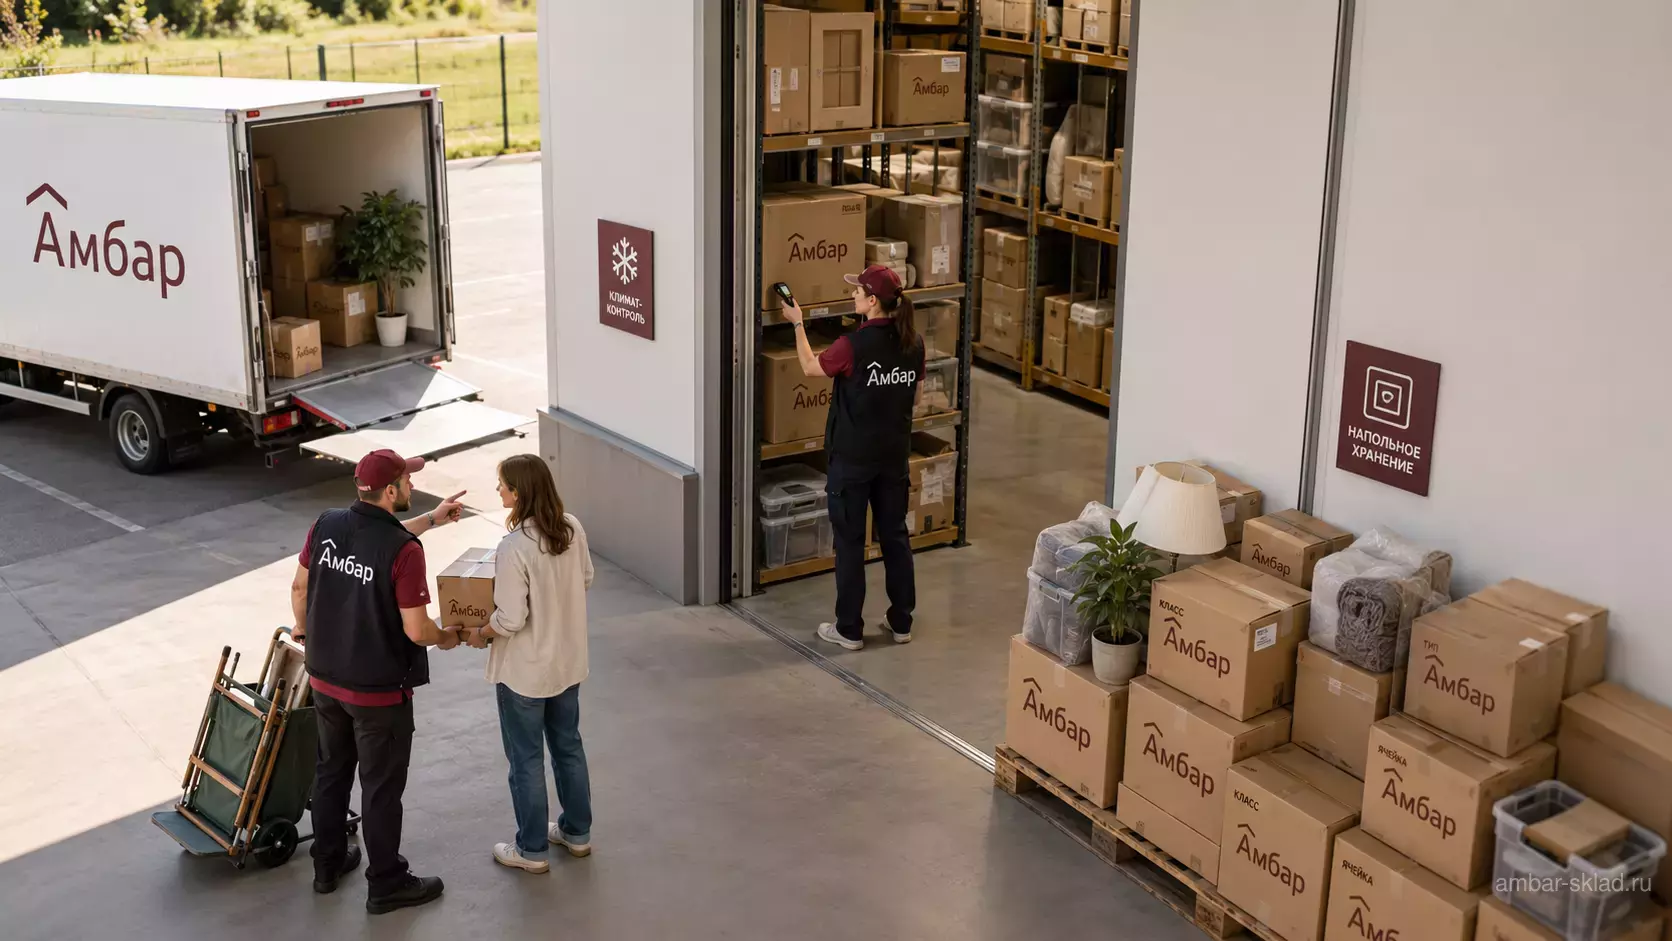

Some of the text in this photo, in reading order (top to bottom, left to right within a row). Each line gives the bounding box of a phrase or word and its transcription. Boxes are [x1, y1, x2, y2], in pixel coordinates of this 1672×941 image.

[912, 81, 950, 97] Амбар
[33, 211, 186, 299] Амбар
[787, 239, 848, 263] Амбар
[606, 304, 645, 324] КОНТРОЛЬ
[609, 291, 643, 308] КЛИМАТ-
[866, 365, 917, 387] Амбар
[793, 388, 833, 410] Амба
[1347, 425, 1422, 460] НАПОЛЬНОЕ
[1351, 443, 1415, 475] ХРАНЕНИЕ
[318, 547, 374, 585] Амбар
[1251, 548, 1291, 578] Амбар
[449, 602, 487, 620] Амбар
[1158, 599, 1185, 617] КЛАСС
[1163, 626, 1231, 679] Амбар
[1423, 665, 1496, 716] Амбар
[1022, 688, 1091, 753] Амбар
[1142, 733, 1216, 798] Амбар
[1377, 744, 1408, 767] ЯЧЕЙКА
[1233, 788, 1260, 812] КЛАСС
[1381, 778, 1458, 840] Амбар
[1235, 833, 1306, 897] Амбар
[1341, 859, 1374, 887] ЯЧЕЙКА
